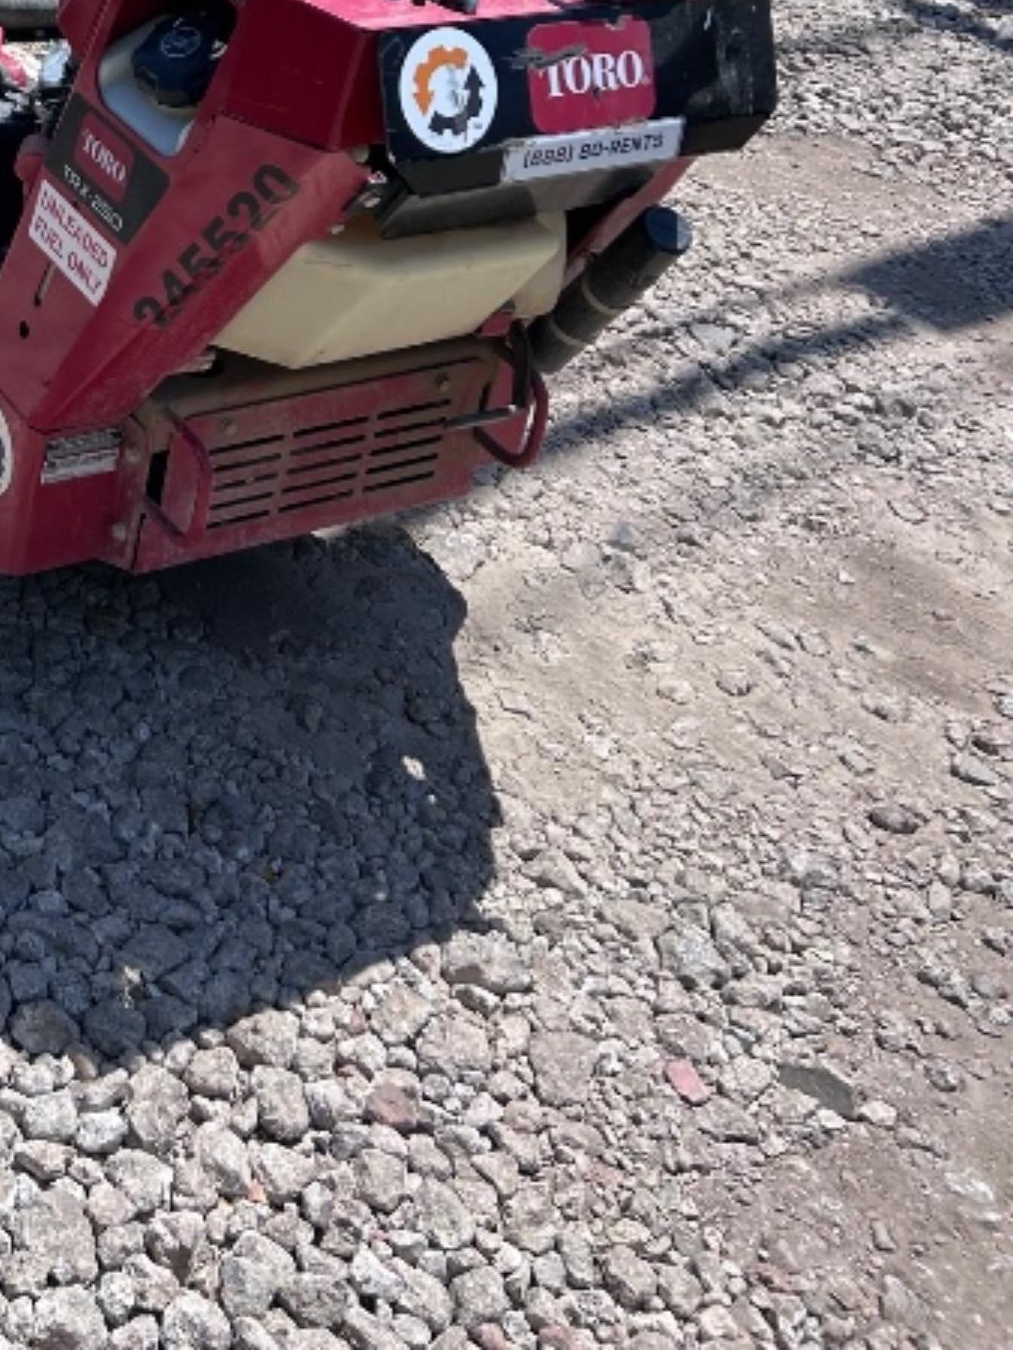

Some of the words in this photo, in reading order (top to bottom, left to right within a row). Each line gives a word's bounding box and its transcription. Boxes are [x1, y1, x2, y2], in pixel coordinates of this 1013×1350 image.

[539, 50, 644, 98] TORO
[83, 132, 127, 183] TORO
[523, 143, 573, 168] (888)
[41, 190, 108, 268] UNLEADED
[63, 164, 124, 232] TRX-250
[34, 216, 64, 259] FUEL
[67, 251, 102, 295] ONLY
[133, 164, 299, 330] 245520
